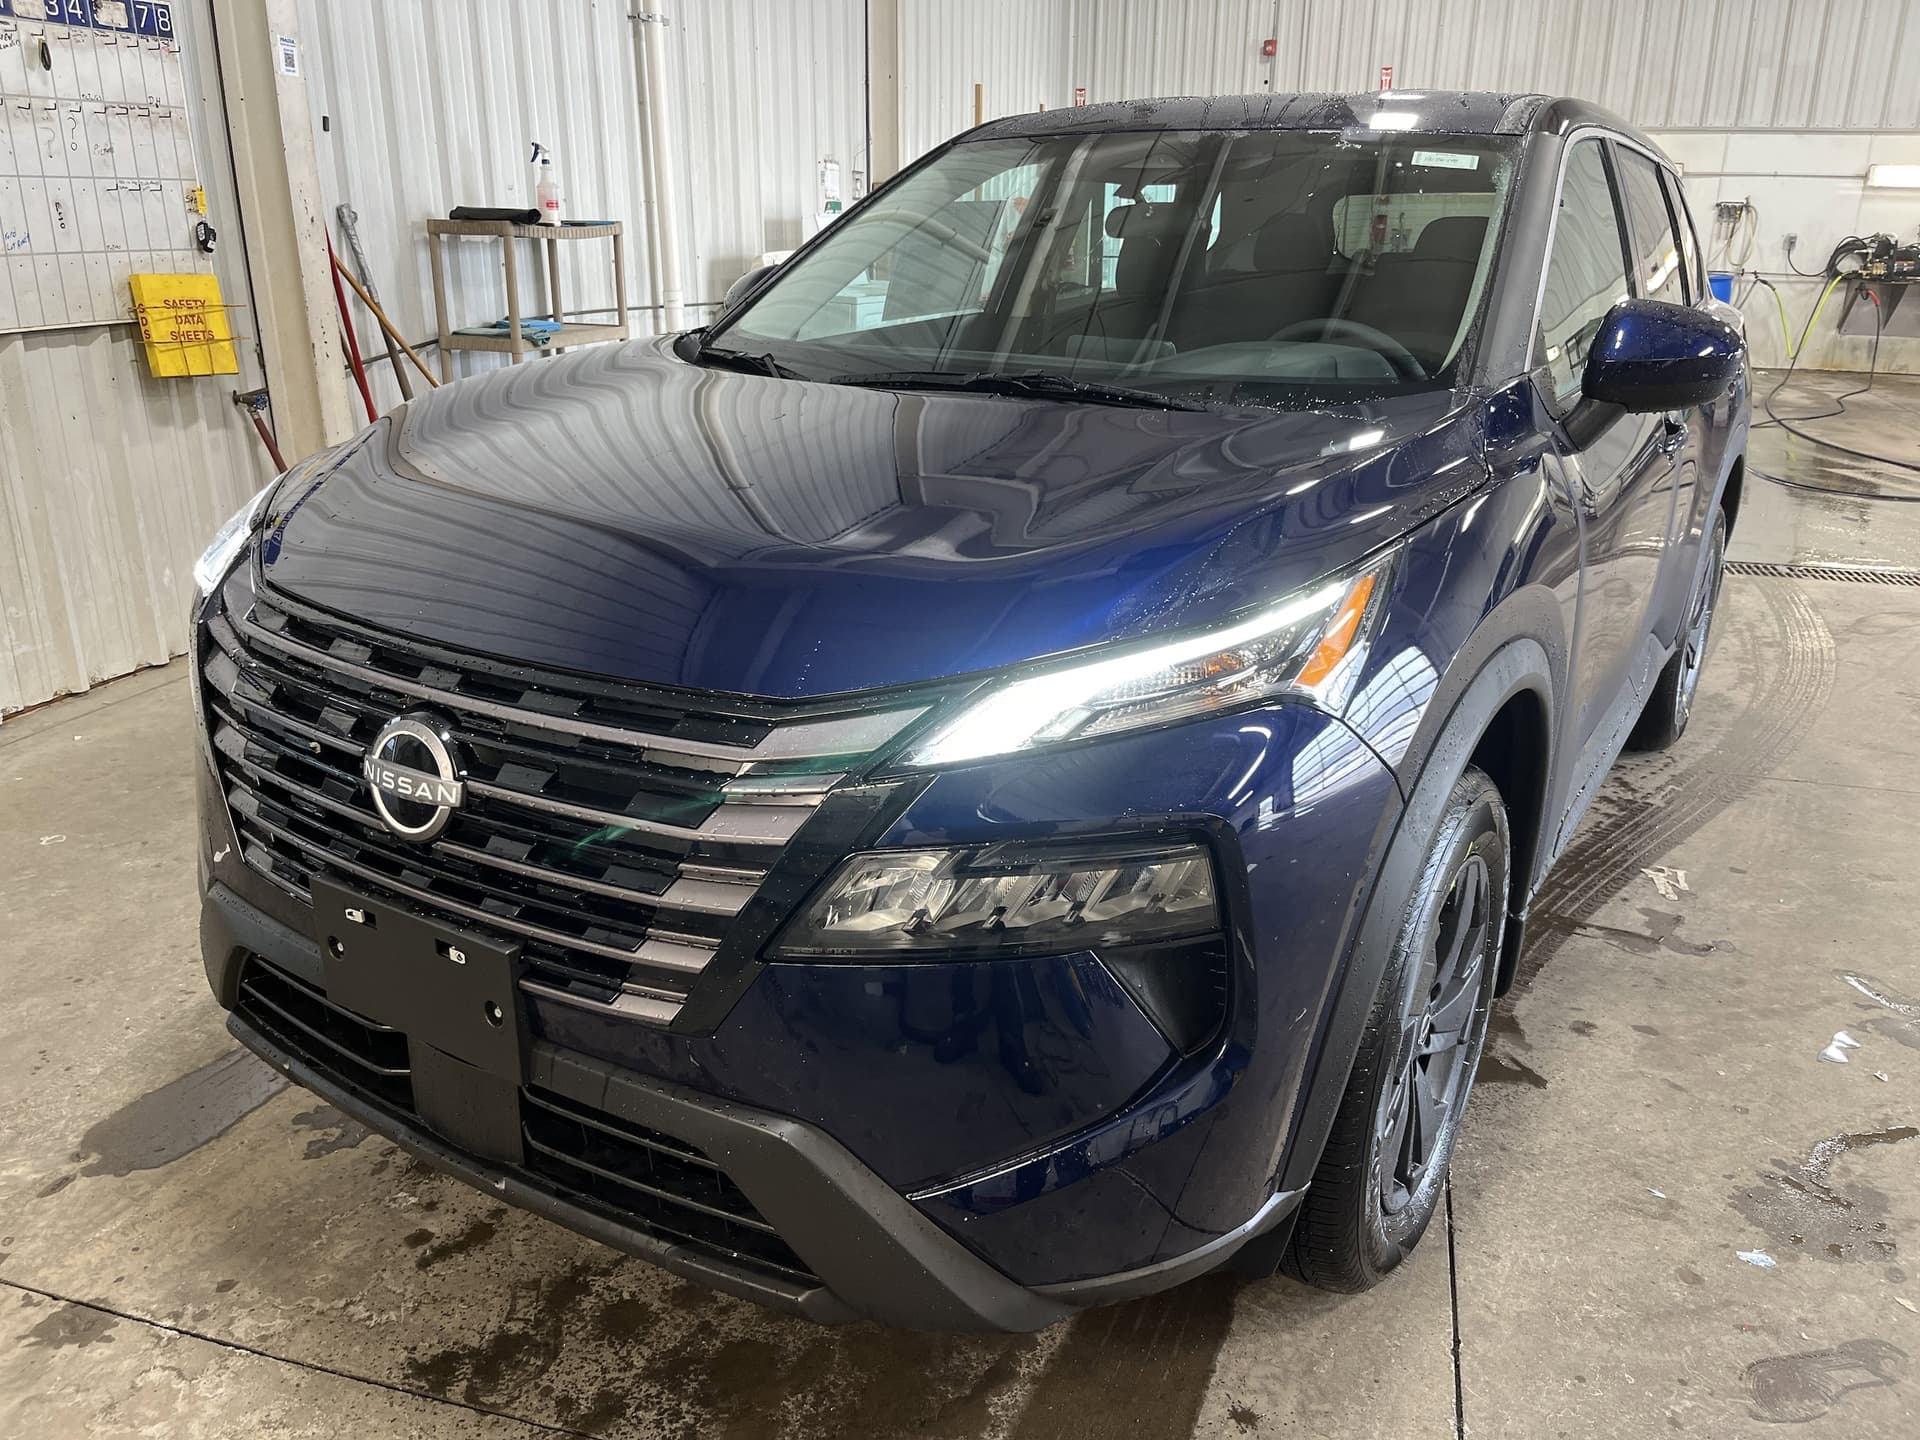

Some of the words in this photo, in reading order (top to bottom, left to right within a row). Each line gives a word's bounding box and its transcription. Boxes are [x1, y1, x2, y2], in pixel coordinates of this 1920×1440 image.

[135, 4, 148, 28] 7
[157, 8, 171, 31] 8
[163, 299, 206, 310] SAFETY
[174, 314, 204, 325] DATA
[169, 330, 215, 341] SHEETS
[364, 760, 457, 804] NISSAN
